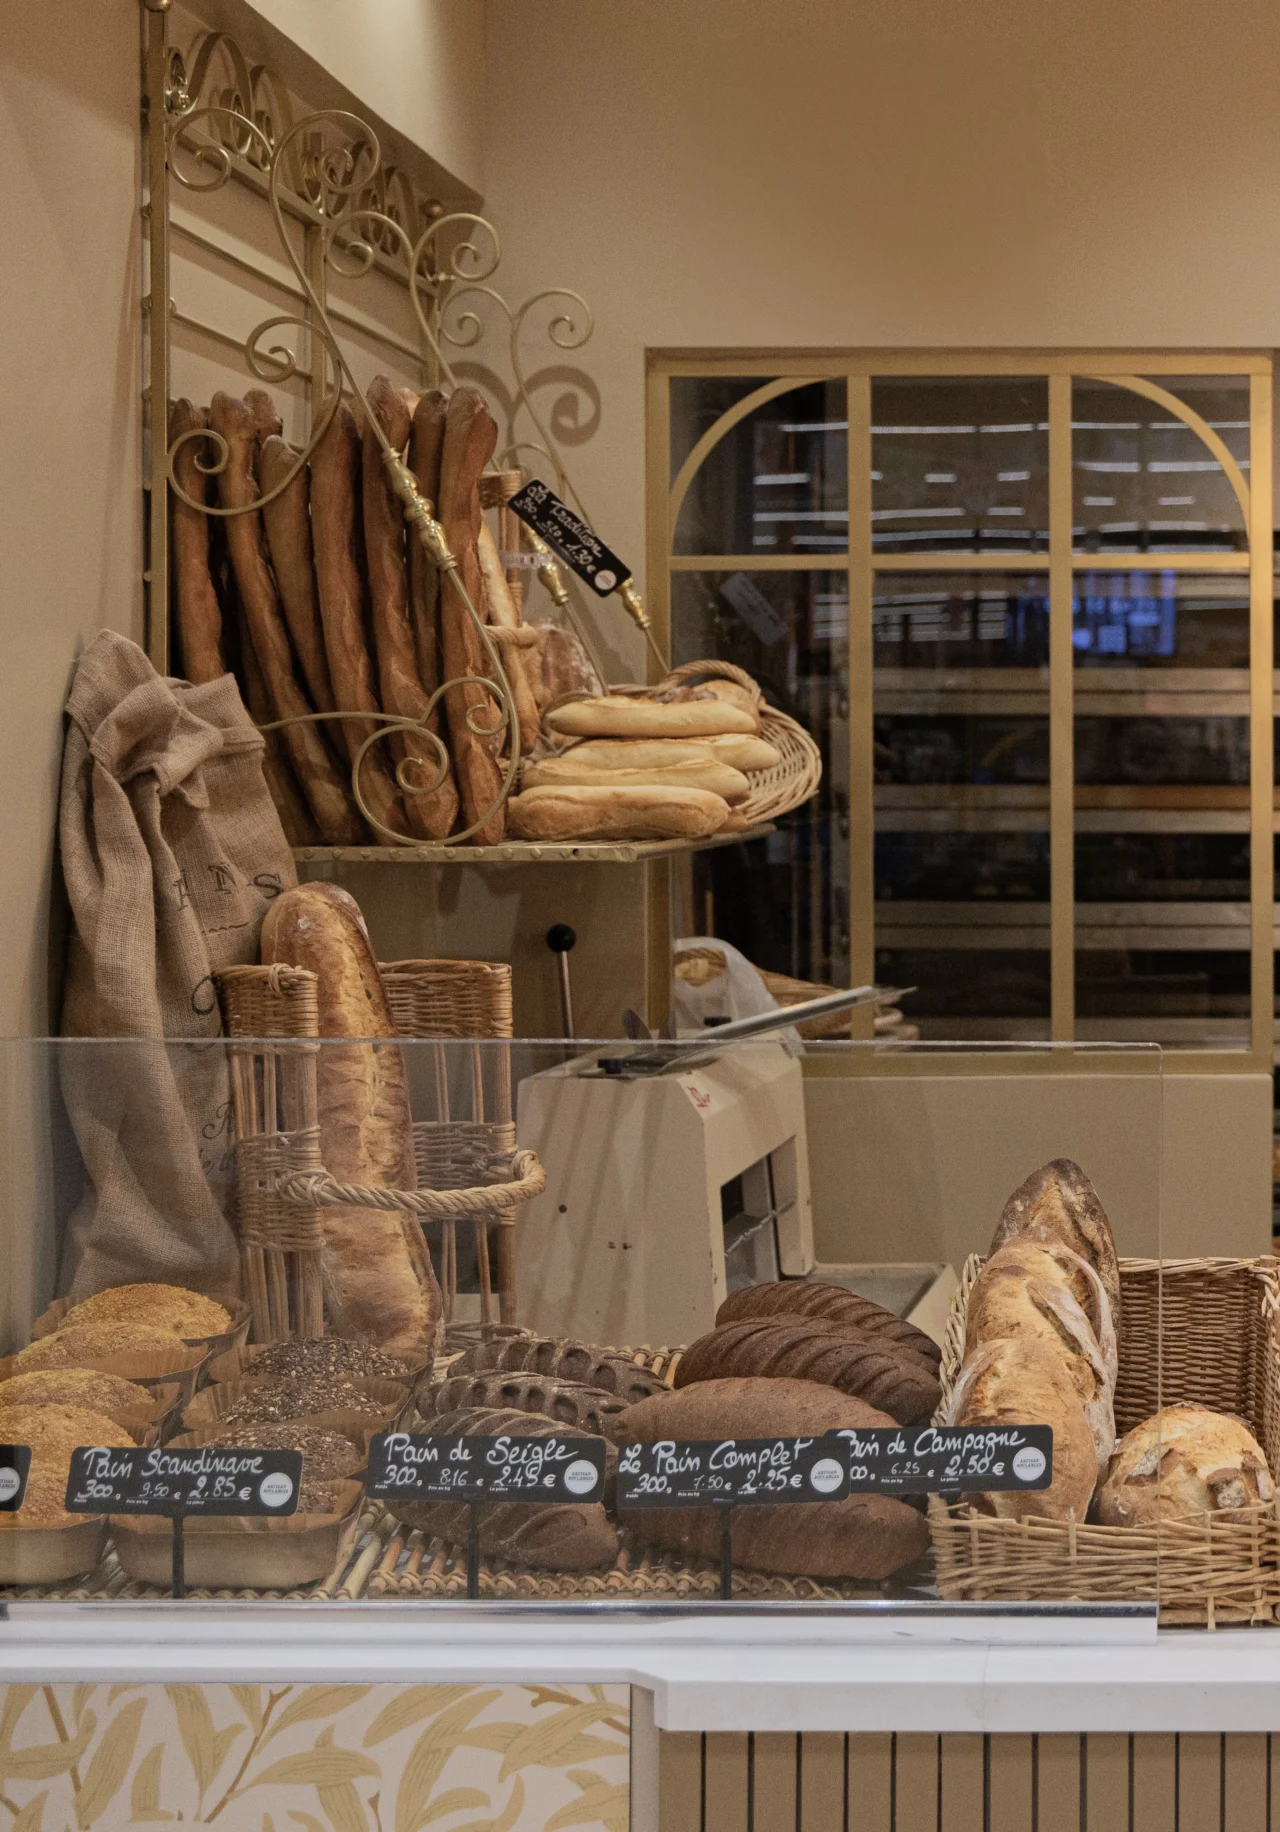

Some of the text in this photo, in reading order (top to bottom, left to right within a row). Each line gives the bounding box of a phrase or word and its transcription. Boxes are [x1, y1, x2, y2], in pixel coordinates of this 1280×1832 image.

[550, 500, 603, 558] Tradition
[384, 1432, 579, 1477] Pain de Seigle
[619, 1437, 814, 1474] Le Pain Complet
[887, 1431, 907, 1455] de
[914, 1428, 1026, 1460] Campagne
[83, 1447, 263, 1478] Pain Scandinave
[384, 1464, 417, 1485] 300
[416, 1479, 423, 1487] g
[440, 1467, 469, 1486] 8.16
[476, 1478, 484, 1487] €
[543, 1473, 556, 1487] €
[850, 1465, 868, 1480] 00
[891, 1461, 920, 1475] 6.25
[927, 1469, 934, 1478] €
[992, 1462, 1005, 1476] €
[78, 1479, 113, 1498] 300
[139, 1482, 169, 1498] 9.50
[173, 1491, 181, 1500] €
[239, 1486, 252, 1501] €
[633, 1472, 667, 1492] 300
[693, 1474, 723, 1490] 7.50
[724, 1482, 732, 1490] €
[790, 1474, 802, 1488] €
